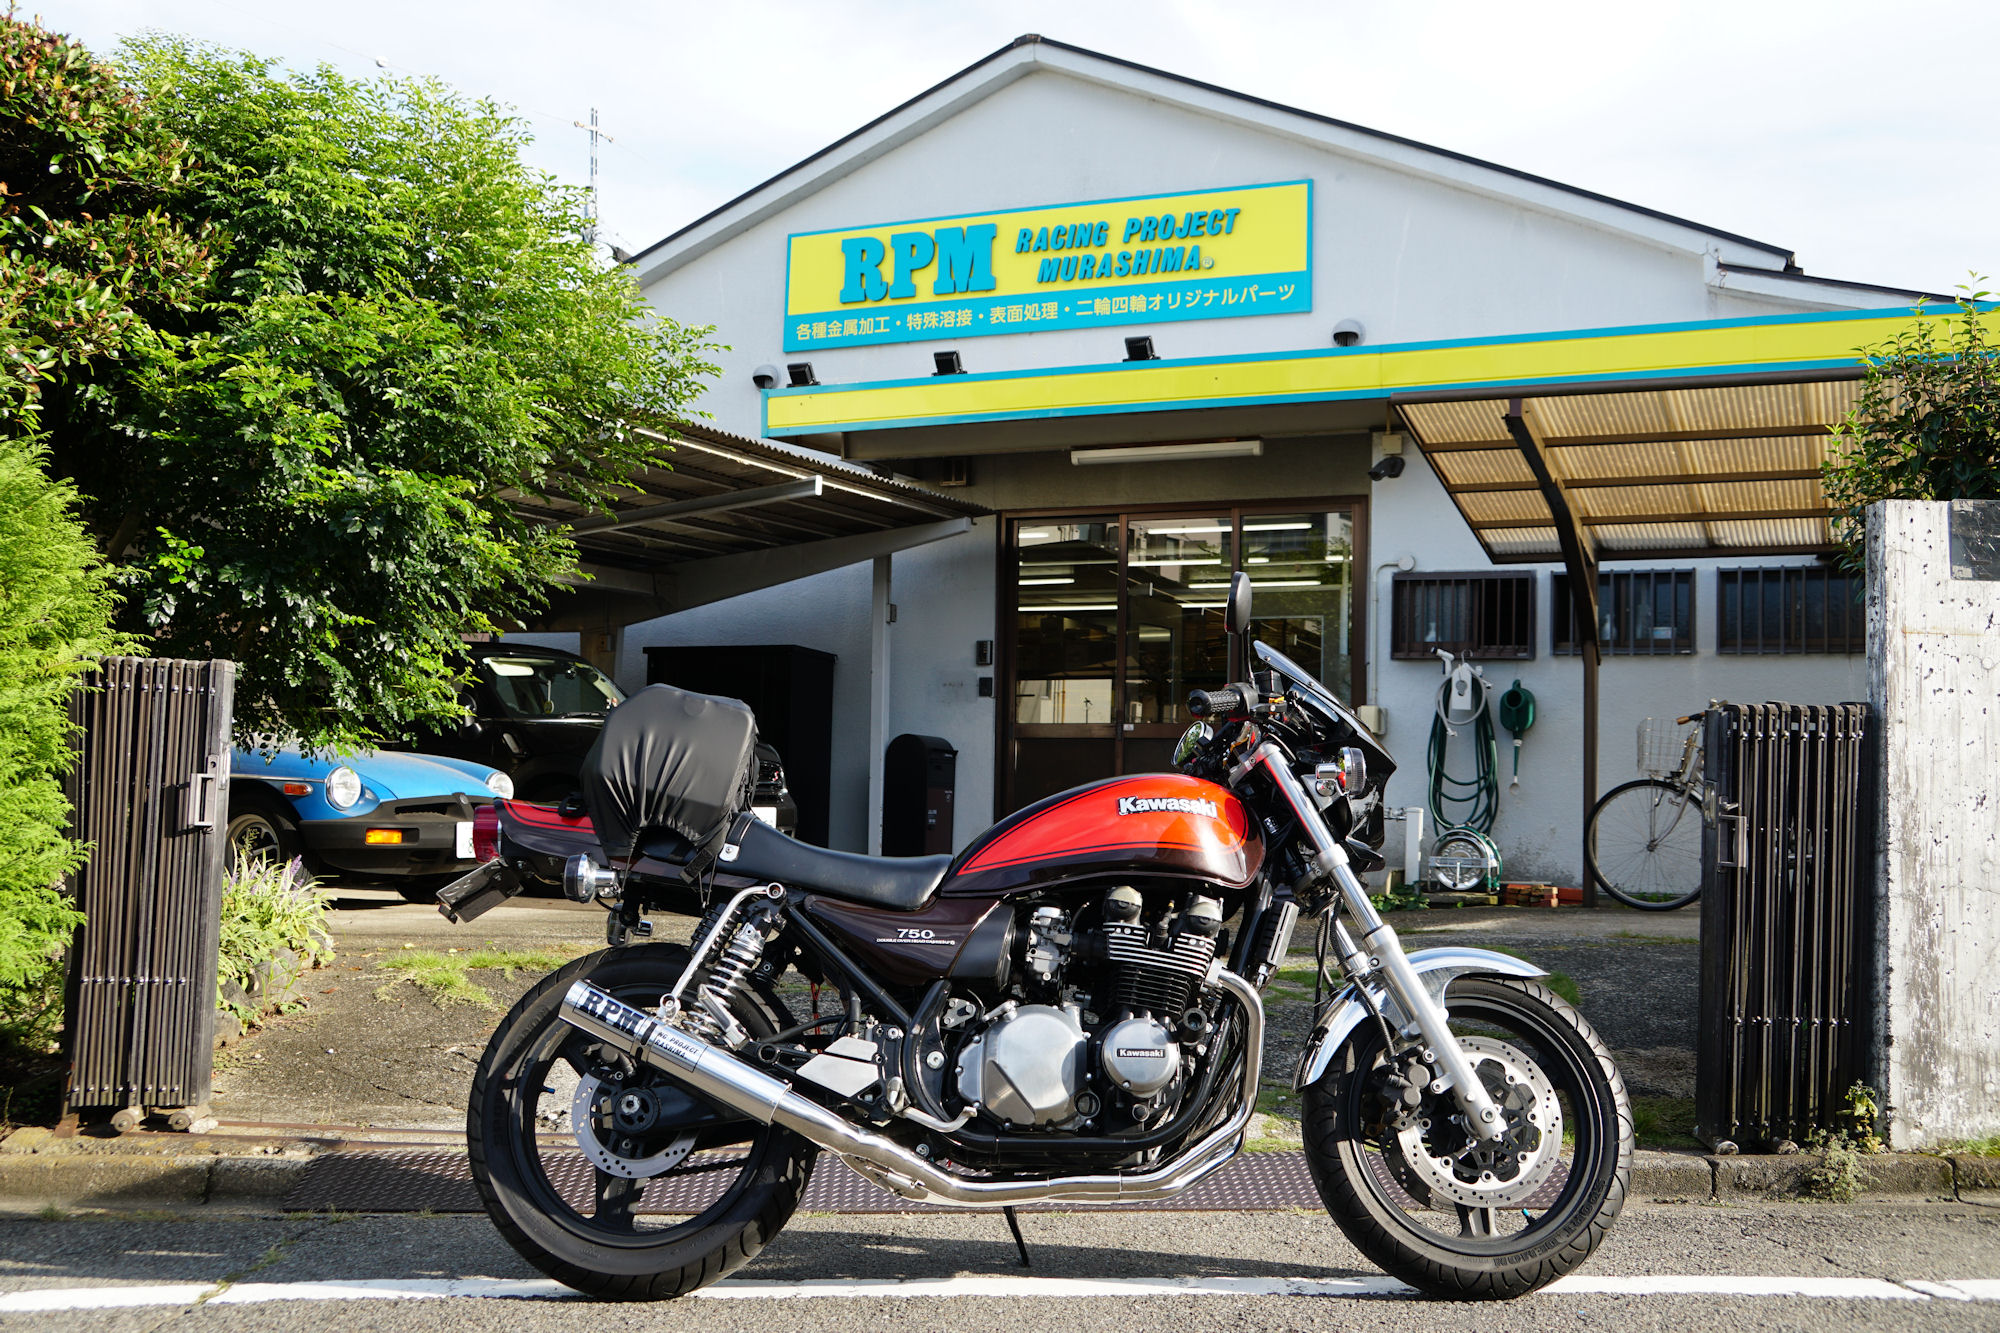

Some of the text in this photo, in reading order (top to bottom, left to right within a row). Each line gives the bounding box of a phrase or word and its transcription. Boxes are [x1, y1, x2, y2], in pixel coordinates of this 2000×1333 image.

[1015, 208, 1241, 253] RACING PROJECT
[840, 223, 997, 304] RPM
[1118, 796, 1218, 819] Kawasaki
[896, 928, 935, 939] 750
[579, 990, 645, 1037] RPM
[669, 1036, 699, 1054] PROJECT
[1119, 1048, 1164, 1057] Kawasaki
